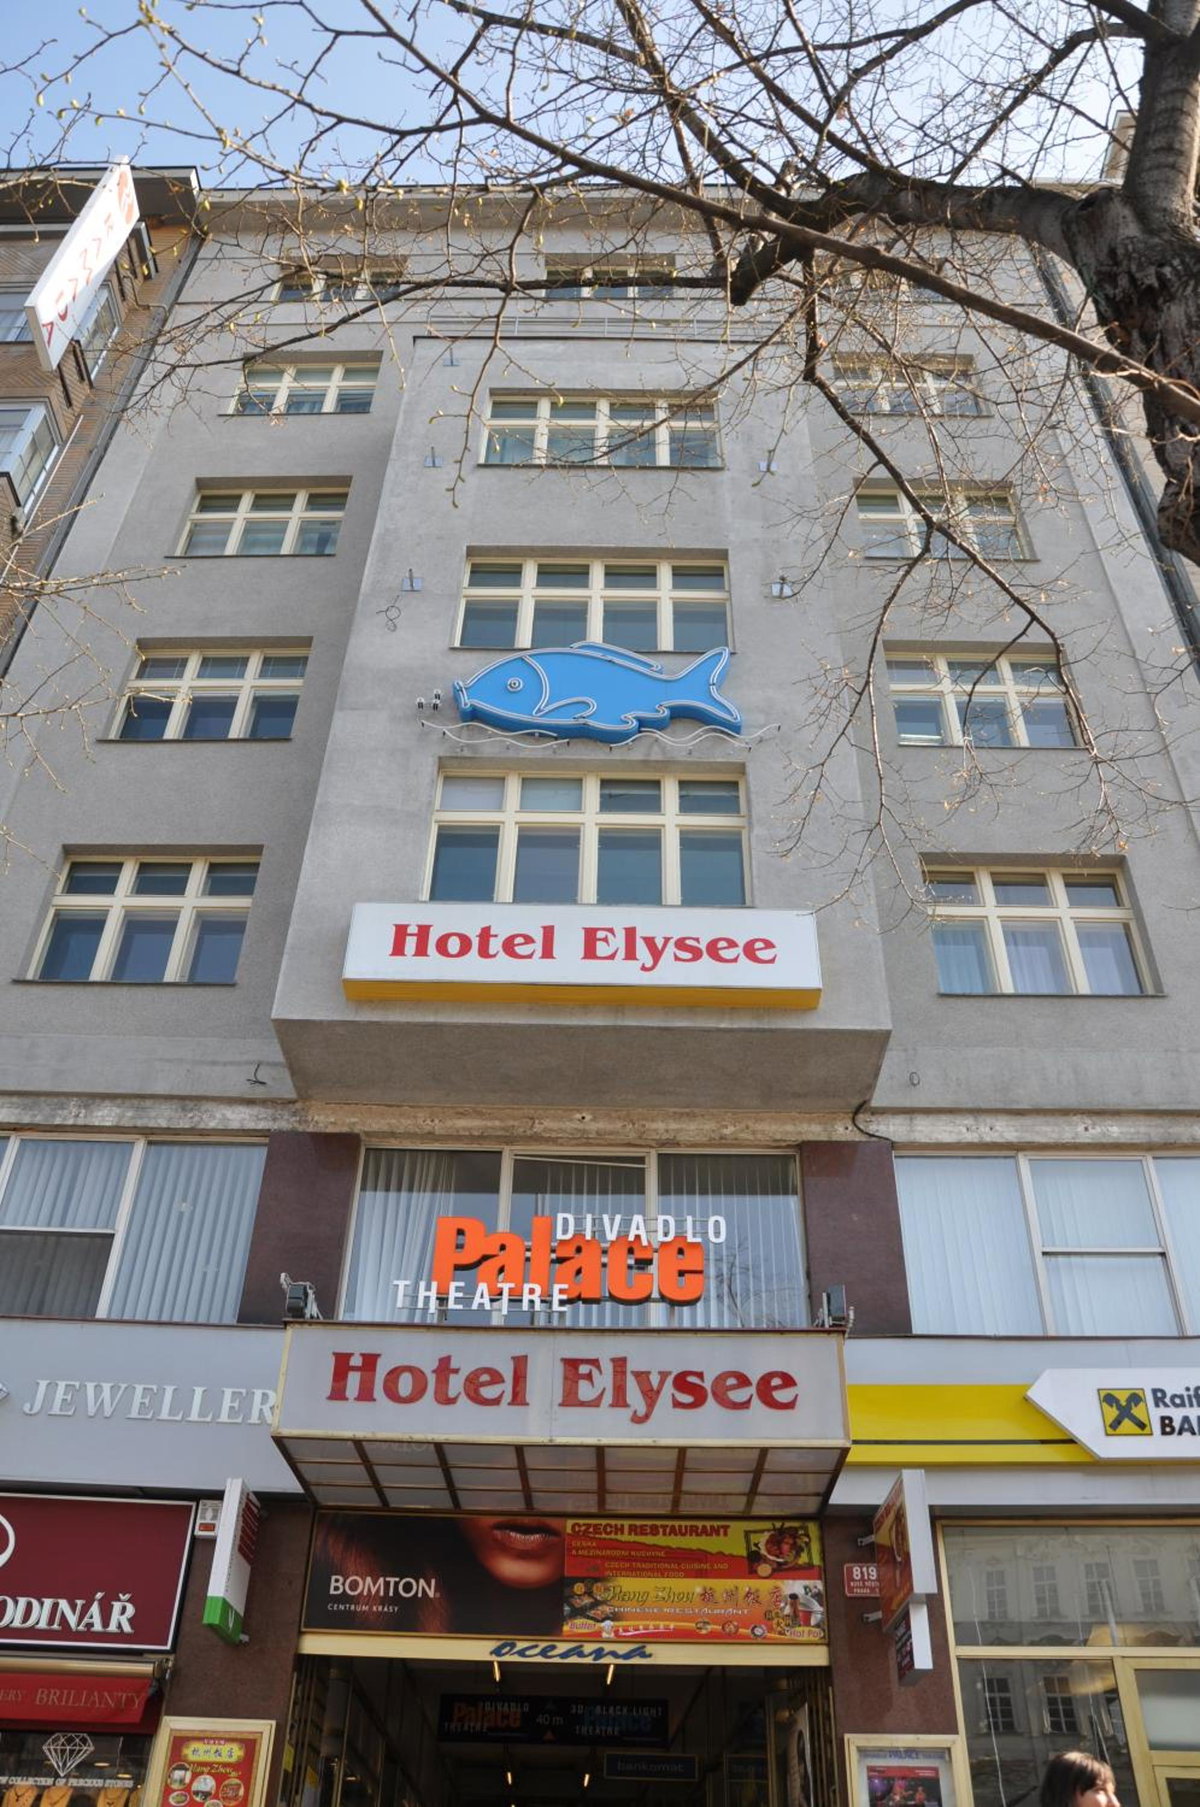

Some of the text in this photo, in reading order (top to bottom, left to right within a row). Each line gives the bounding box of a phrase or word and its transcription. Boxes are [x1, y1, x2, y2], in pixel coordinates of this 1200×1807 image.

[389, 924, 777, 972] Hotel Elysee
[556, 1212, 726, 1246] DIVADLO
[432, 1216, 705, 1305] Palace
[393, 1280, 569, 1315] THEATRE
[325, 1351, 799, 1424] Hotel Elysee
[23, 1379, 277, 1425] JEWELLER
[1159, 1415, 1200, 1437] BA
[571, 1522, 731, 1538] CZECH RESTAURANT
[852, 1566, 877, 1580] 819
[329, 1575, 436, 1599] BOMTON
[327, 1602, 399, 1614] CENTRUM KRÁSY
[489, 1641, 653, 1662] oceana
[535, 1713, 551, 1724] 40
